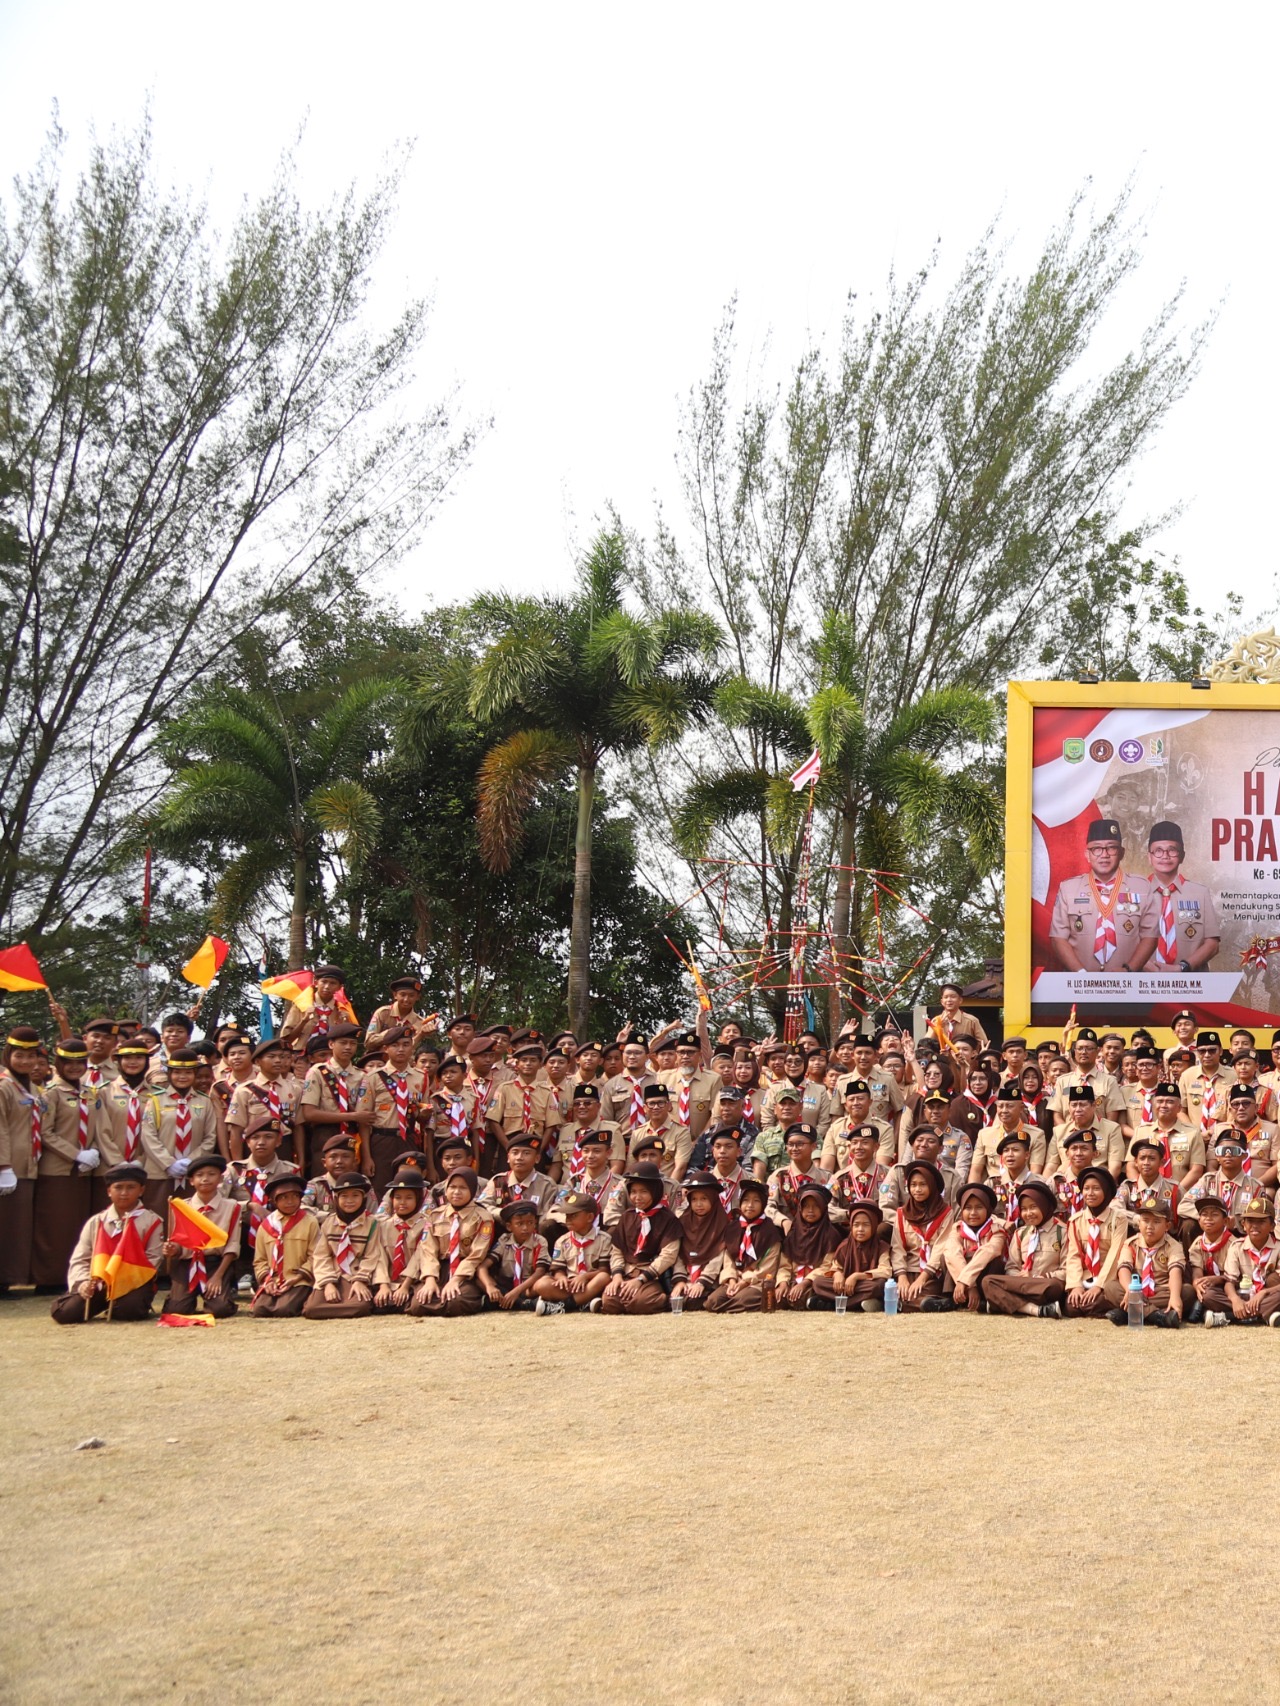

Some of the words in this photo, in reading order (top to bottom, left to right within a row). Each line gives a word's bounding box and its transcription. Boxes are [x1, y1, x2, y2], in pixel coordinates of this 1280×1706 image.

[1253, 868, 1265, 880] Ke
[1222, 903, 1274, 912] Mendukung
[1233, 913, 1266, 922] Menuju
[1268, 941, 1278, 949] 28
[1073, 980, 1082, 988] LIS
[1083, 980, 1121, 989] DARMANSYAH,
[1122, 980, 1133, 988] S.H.
[1139, 980, 1149, 989] Drs.
[1157, 980, 1170, 988] RAJA
[1171, 980, 1188, 989] ARIZA,
